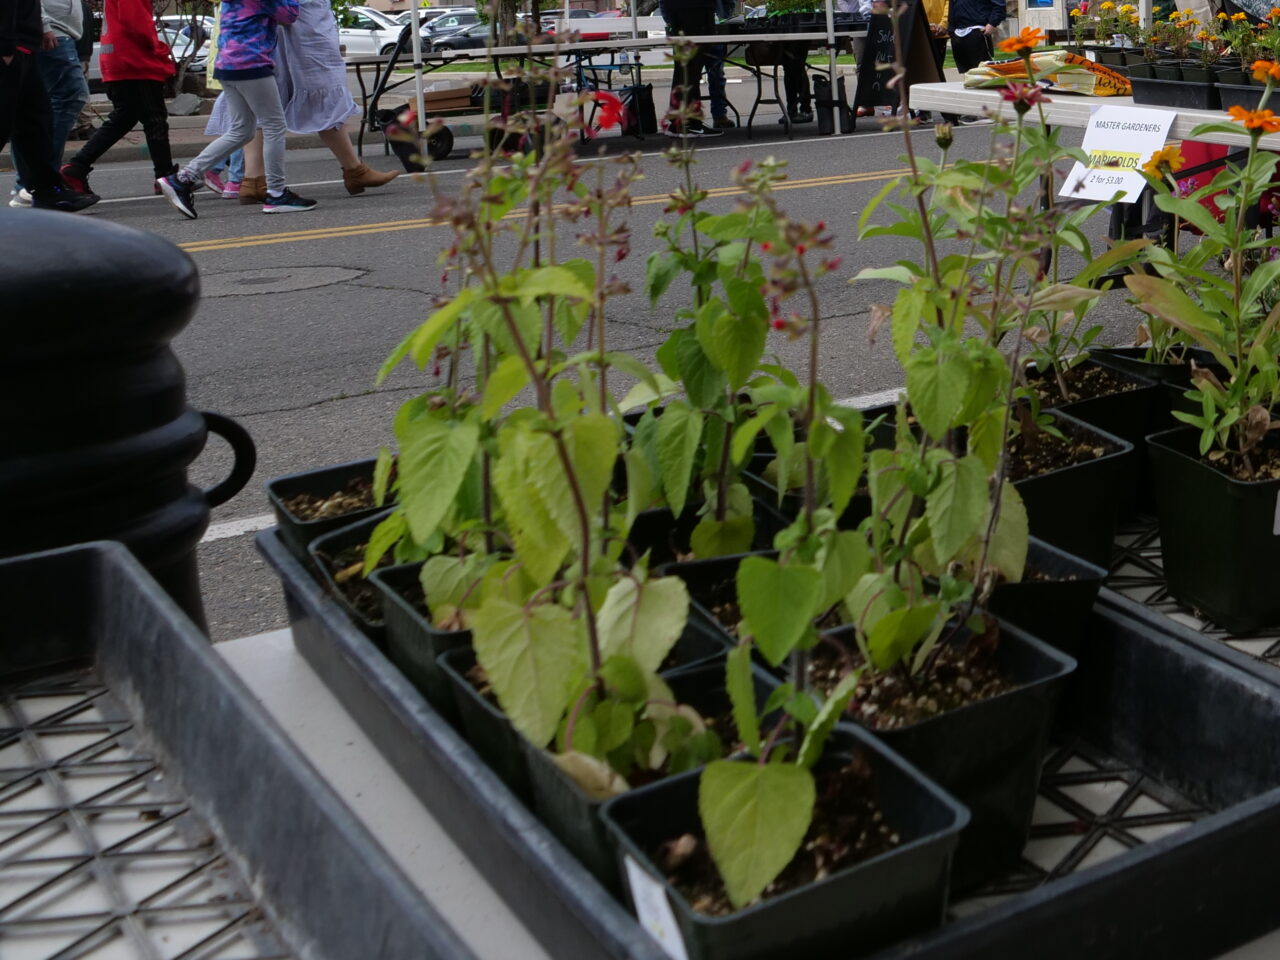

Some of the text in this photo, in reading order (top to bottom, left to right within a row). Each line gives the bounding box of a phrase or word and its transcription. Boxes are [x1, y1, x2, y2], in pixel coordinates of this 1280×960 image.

[1094, 120, 1161, 133] MASTER GARDENERS
[1088, 153, 1140, 168] MARIGOLDS
[1095, 175, 1105, 183] for
